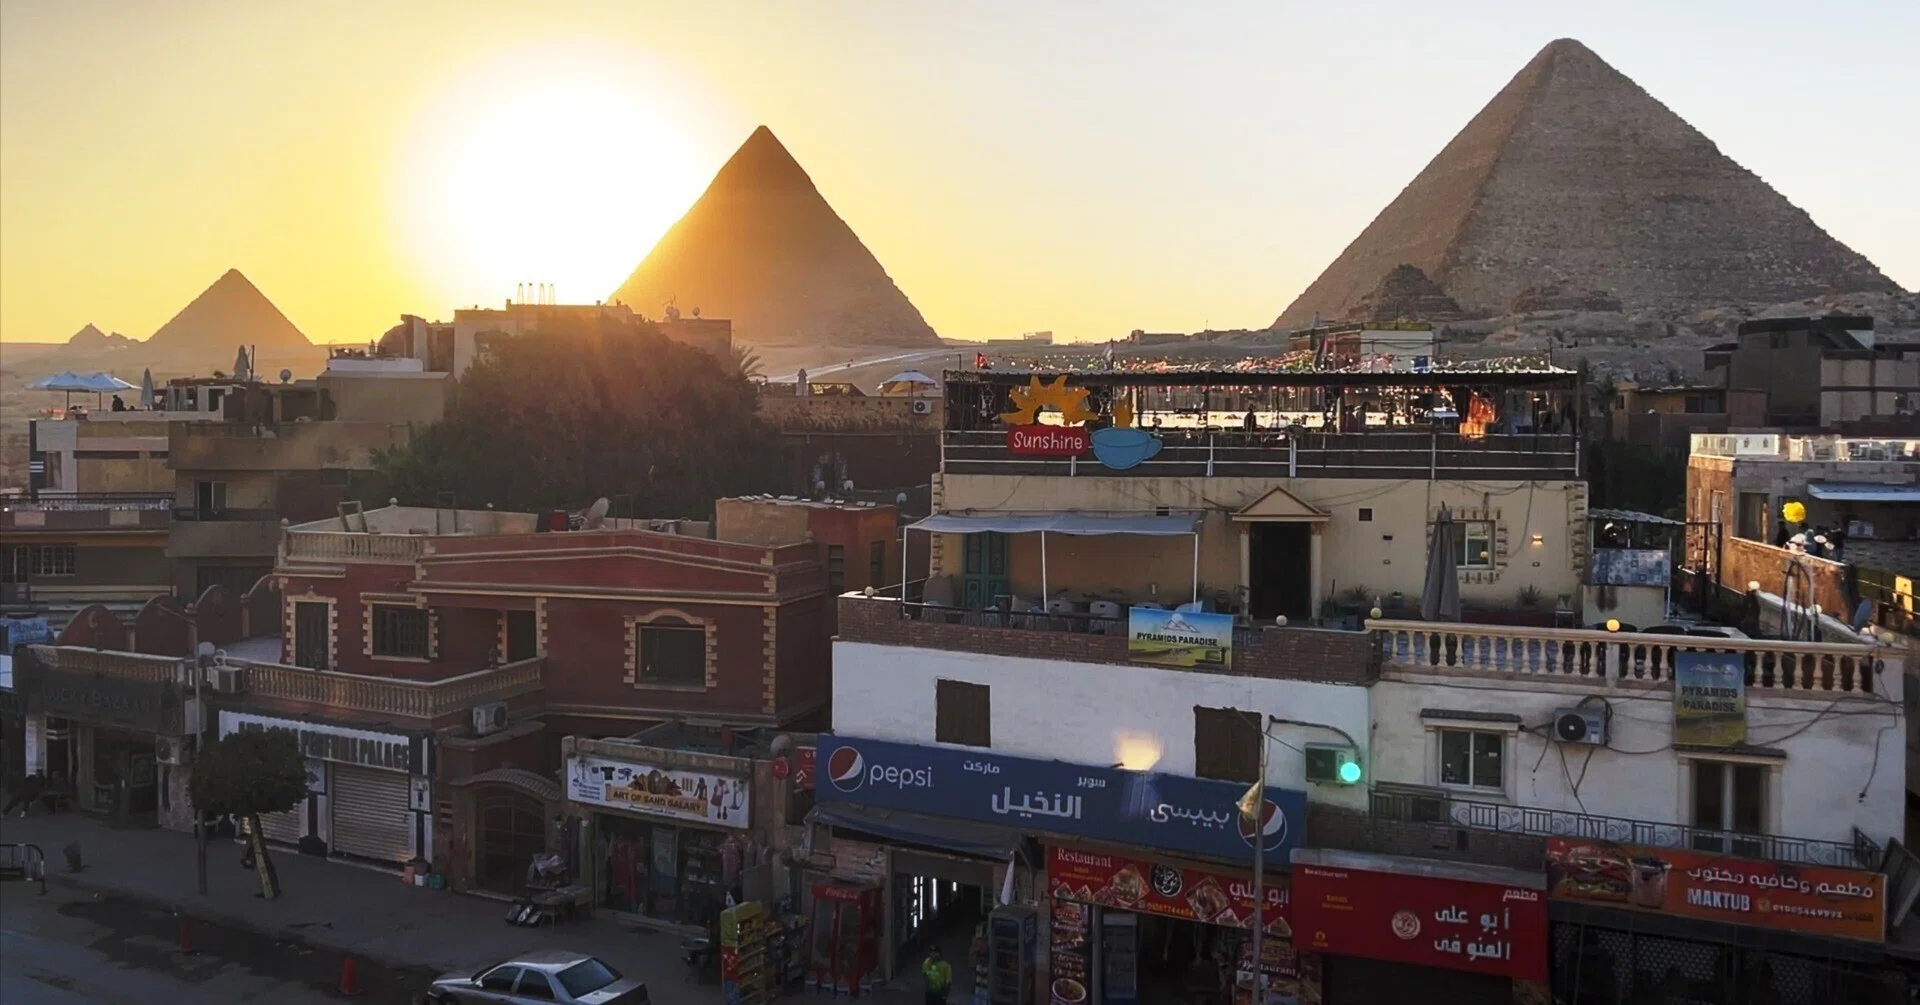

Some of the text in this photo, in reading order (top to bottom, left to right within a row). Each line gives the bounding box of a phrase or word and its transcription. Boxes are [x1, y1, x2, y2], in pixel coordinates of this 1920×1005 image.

[1013, 431, 1083, 450] Sunshine
[1137, 632, 1218, 647] PYRAMIDS PARADISE
[43, 686, 88, 706] LUCKY
[1682, 686, 1738, 698] PYRAMIDS
[1683, 700, 1736, 712] PARADISE
[359, 738, 409, 769] PALACE
[870, 765, 932, 789] pepsi
[963, 760, 1106, 788] سوبر ماركت
[613, 790, 629, 801] ART
[630, 793, 642, 802] OF
[991, 786, 1082, 819] النخيل
[1057, 848, 1112, 868] Restaurant
[1687, 867, 1874, 898] مطعم وكافيه مكتوب
[1502, 888, 1538, 902] مطعم
[1687, 888, 1750, 911] MAKTUB
[1480, 907, 1509, 935] أبو
[1242, 959, 1297, 976] Retaurant
